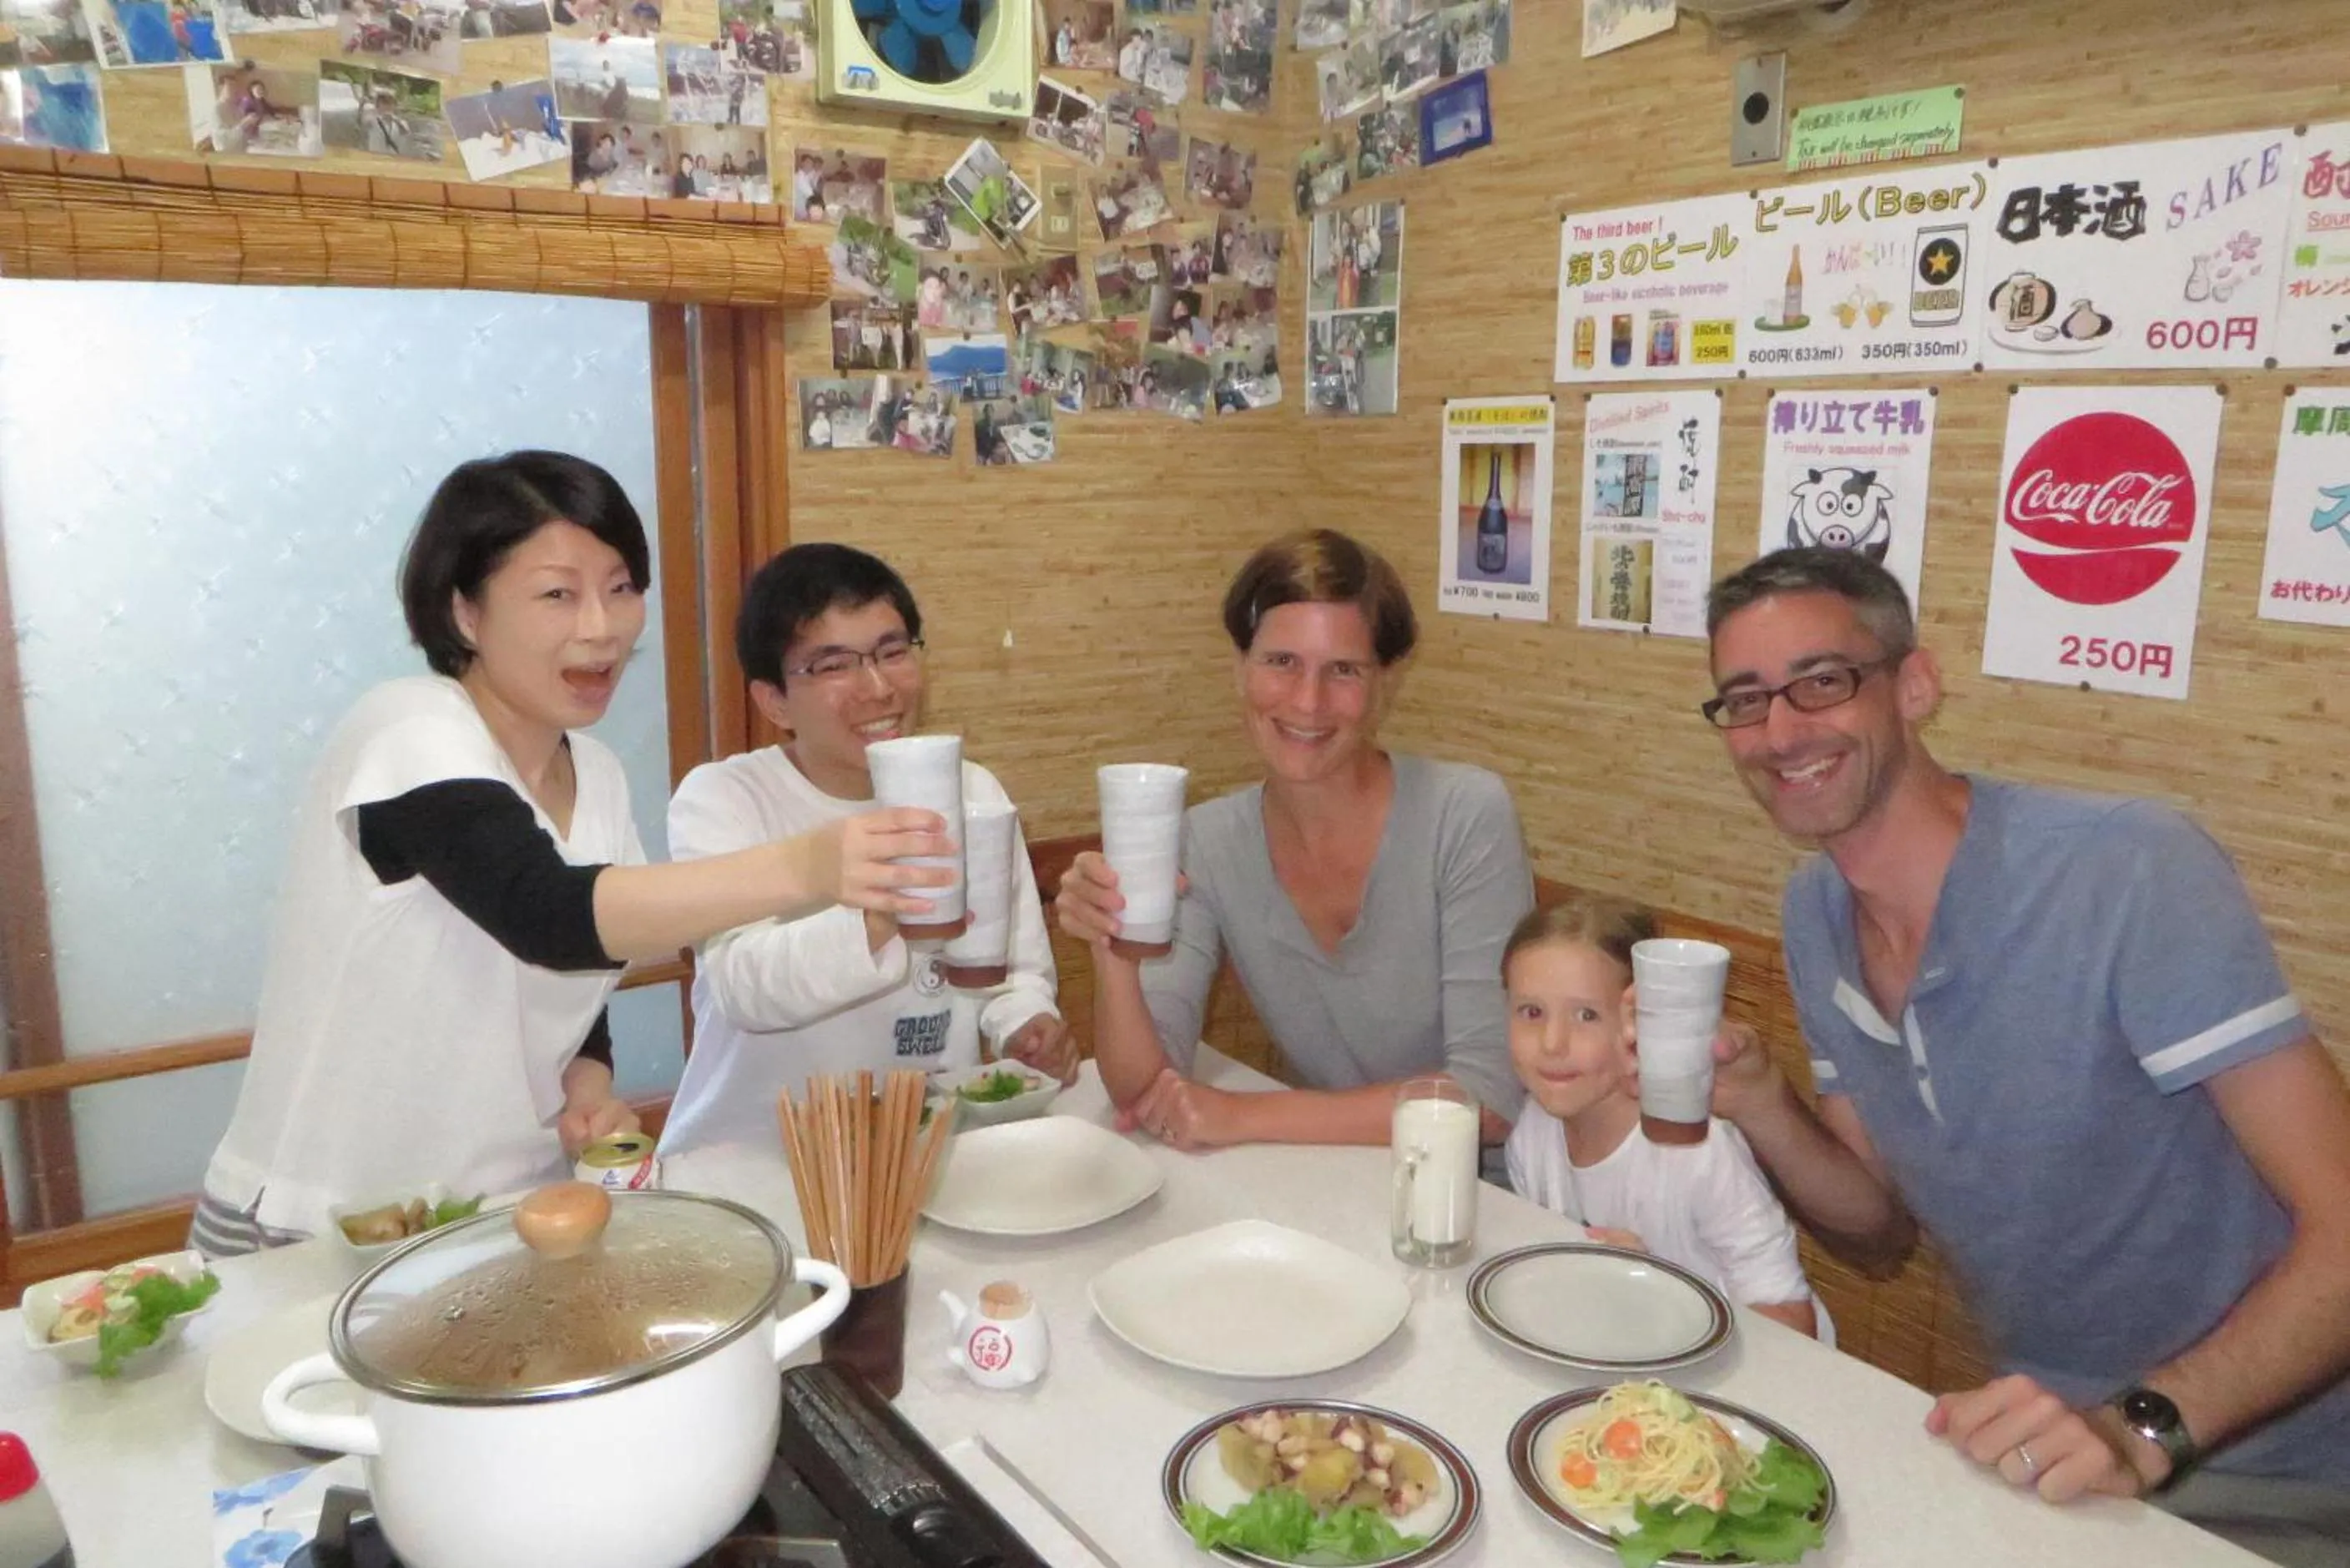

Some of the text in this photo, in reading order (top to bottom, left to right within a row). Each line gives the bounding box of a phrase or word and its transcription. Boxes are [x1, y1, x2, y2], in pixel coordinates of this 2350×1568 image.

[1996, 180, 2147, 245] 日本酒
[2166, 143, 2282, 232] SAKE
[1566, 222, 1740, 288] 第3のビール
[1573, 224, 1592, 241] The
[1596, 221, 1623, 239] third
[2146, 316, 2258, 350] 600円
[1783, 441, 1824, 456] Freshly
[1887, 442, 1911, 456] milk
[2011, 469, 2186, 528] Coca-Cola
[2059, 634, 2173, 678] 250円
